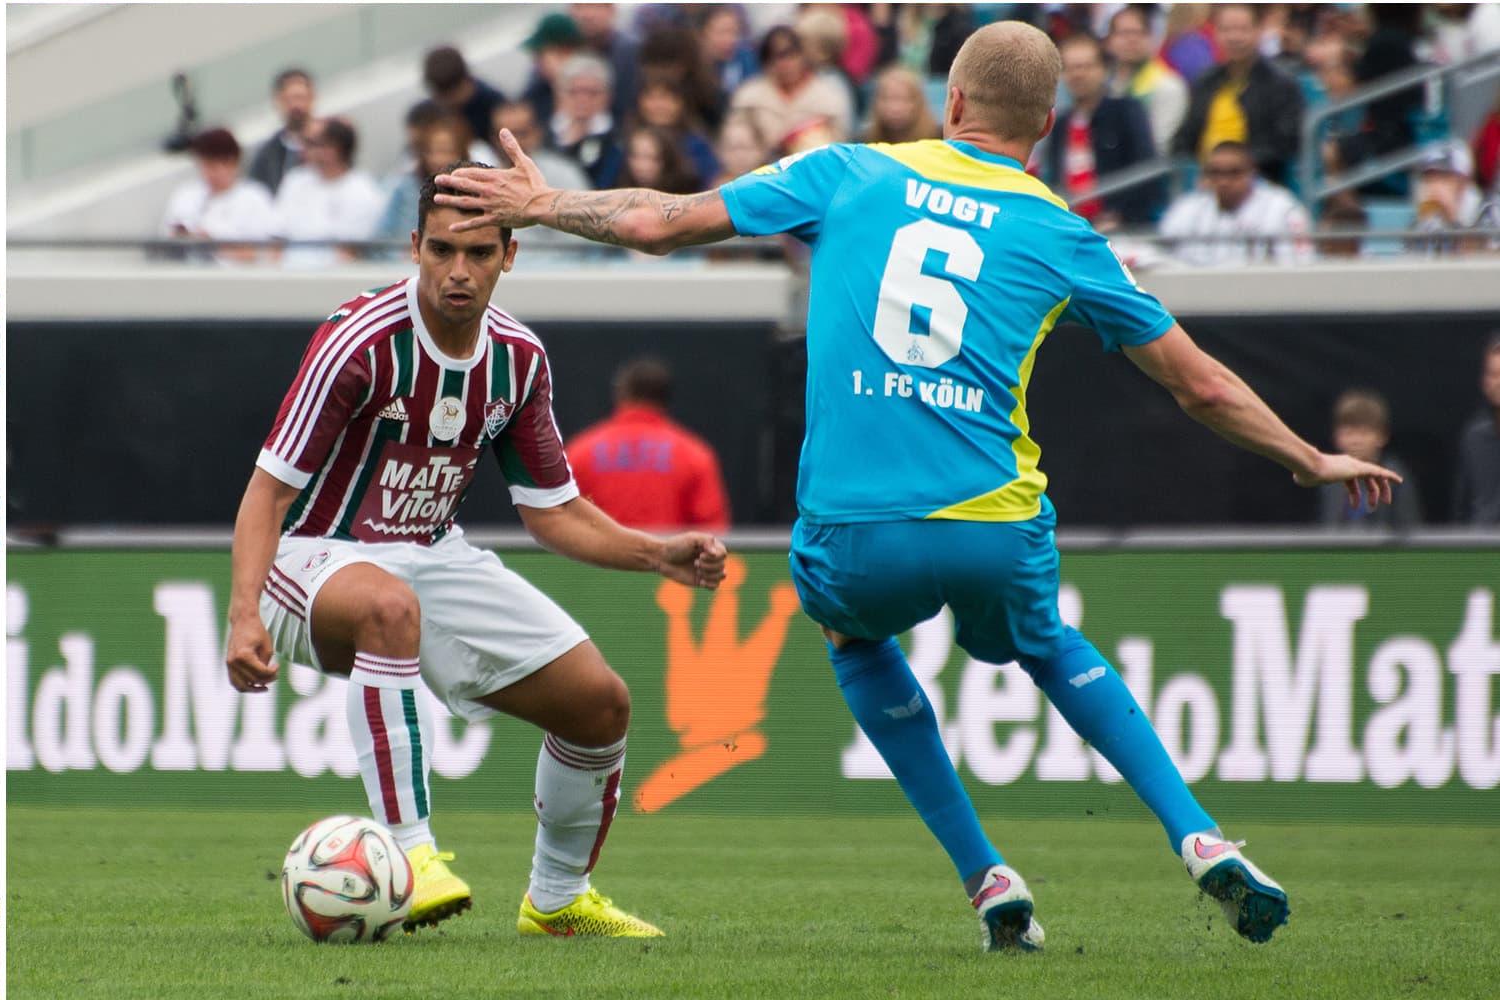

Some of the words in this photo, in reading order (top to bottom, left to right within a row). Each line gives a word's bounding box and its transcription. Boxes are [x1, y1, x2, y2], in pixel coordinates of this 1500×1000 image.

[904, 177, 1000, 230] VOGT
[872, 217, 986, 370] 6
[852, 370, 873, 396] 1.
[884, 371, 913, 398] FC
[918, 377, 984, 413] KÖLN
[377, 409, 409, 422] adidas
[379, 456, 464, 494] MATTE
